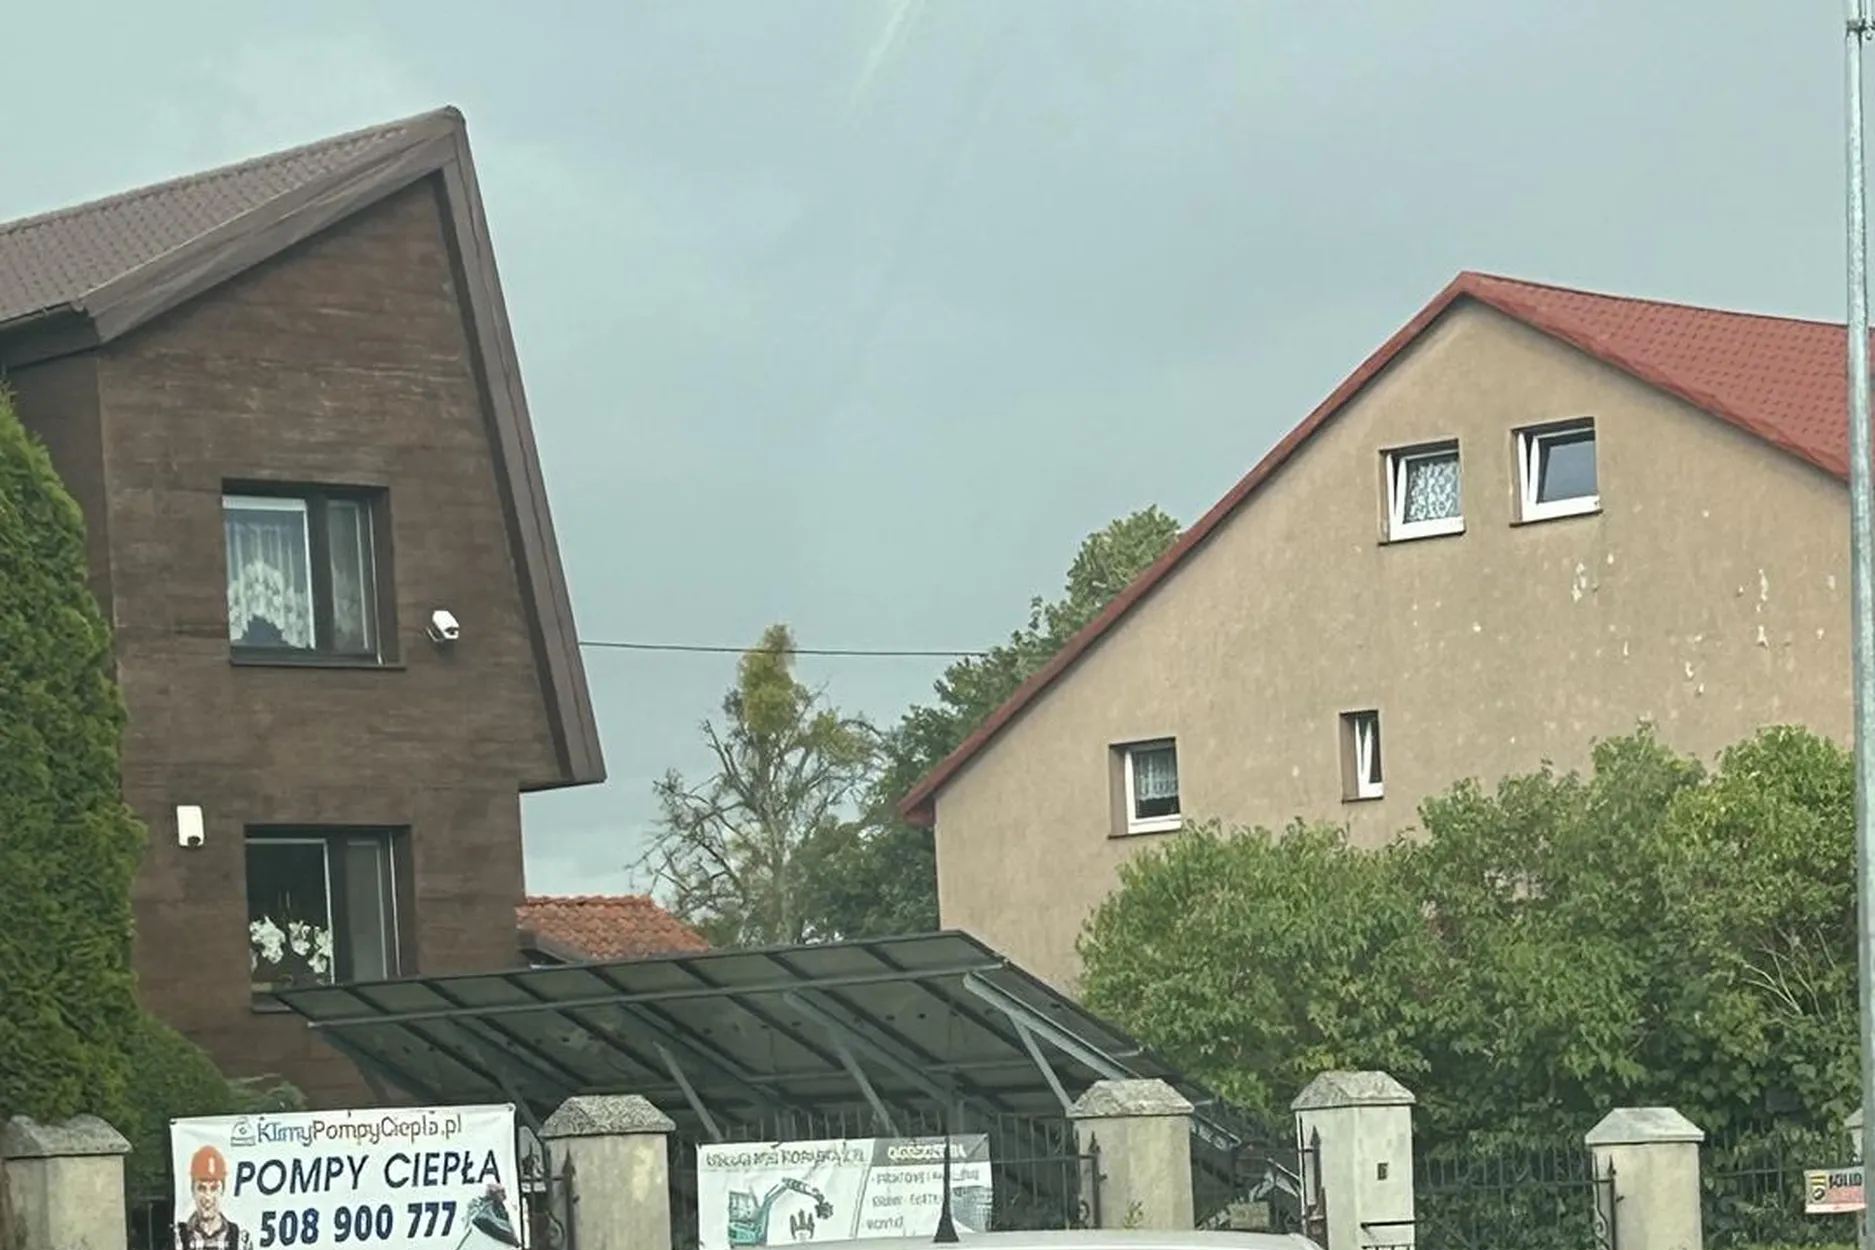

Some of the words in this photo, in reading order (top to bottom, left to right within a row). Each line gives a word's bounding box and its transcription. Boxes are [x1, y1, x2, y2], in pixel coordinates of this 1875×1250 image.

[233, 1155, 370, 1197] POMPY
[384, 1149, 501, 1189] CIEPŁA
[259, 1207, 320, 1248] 508
[333, 1203, 394, 1243] 900
[406, 1200, 457, 1239] 777
